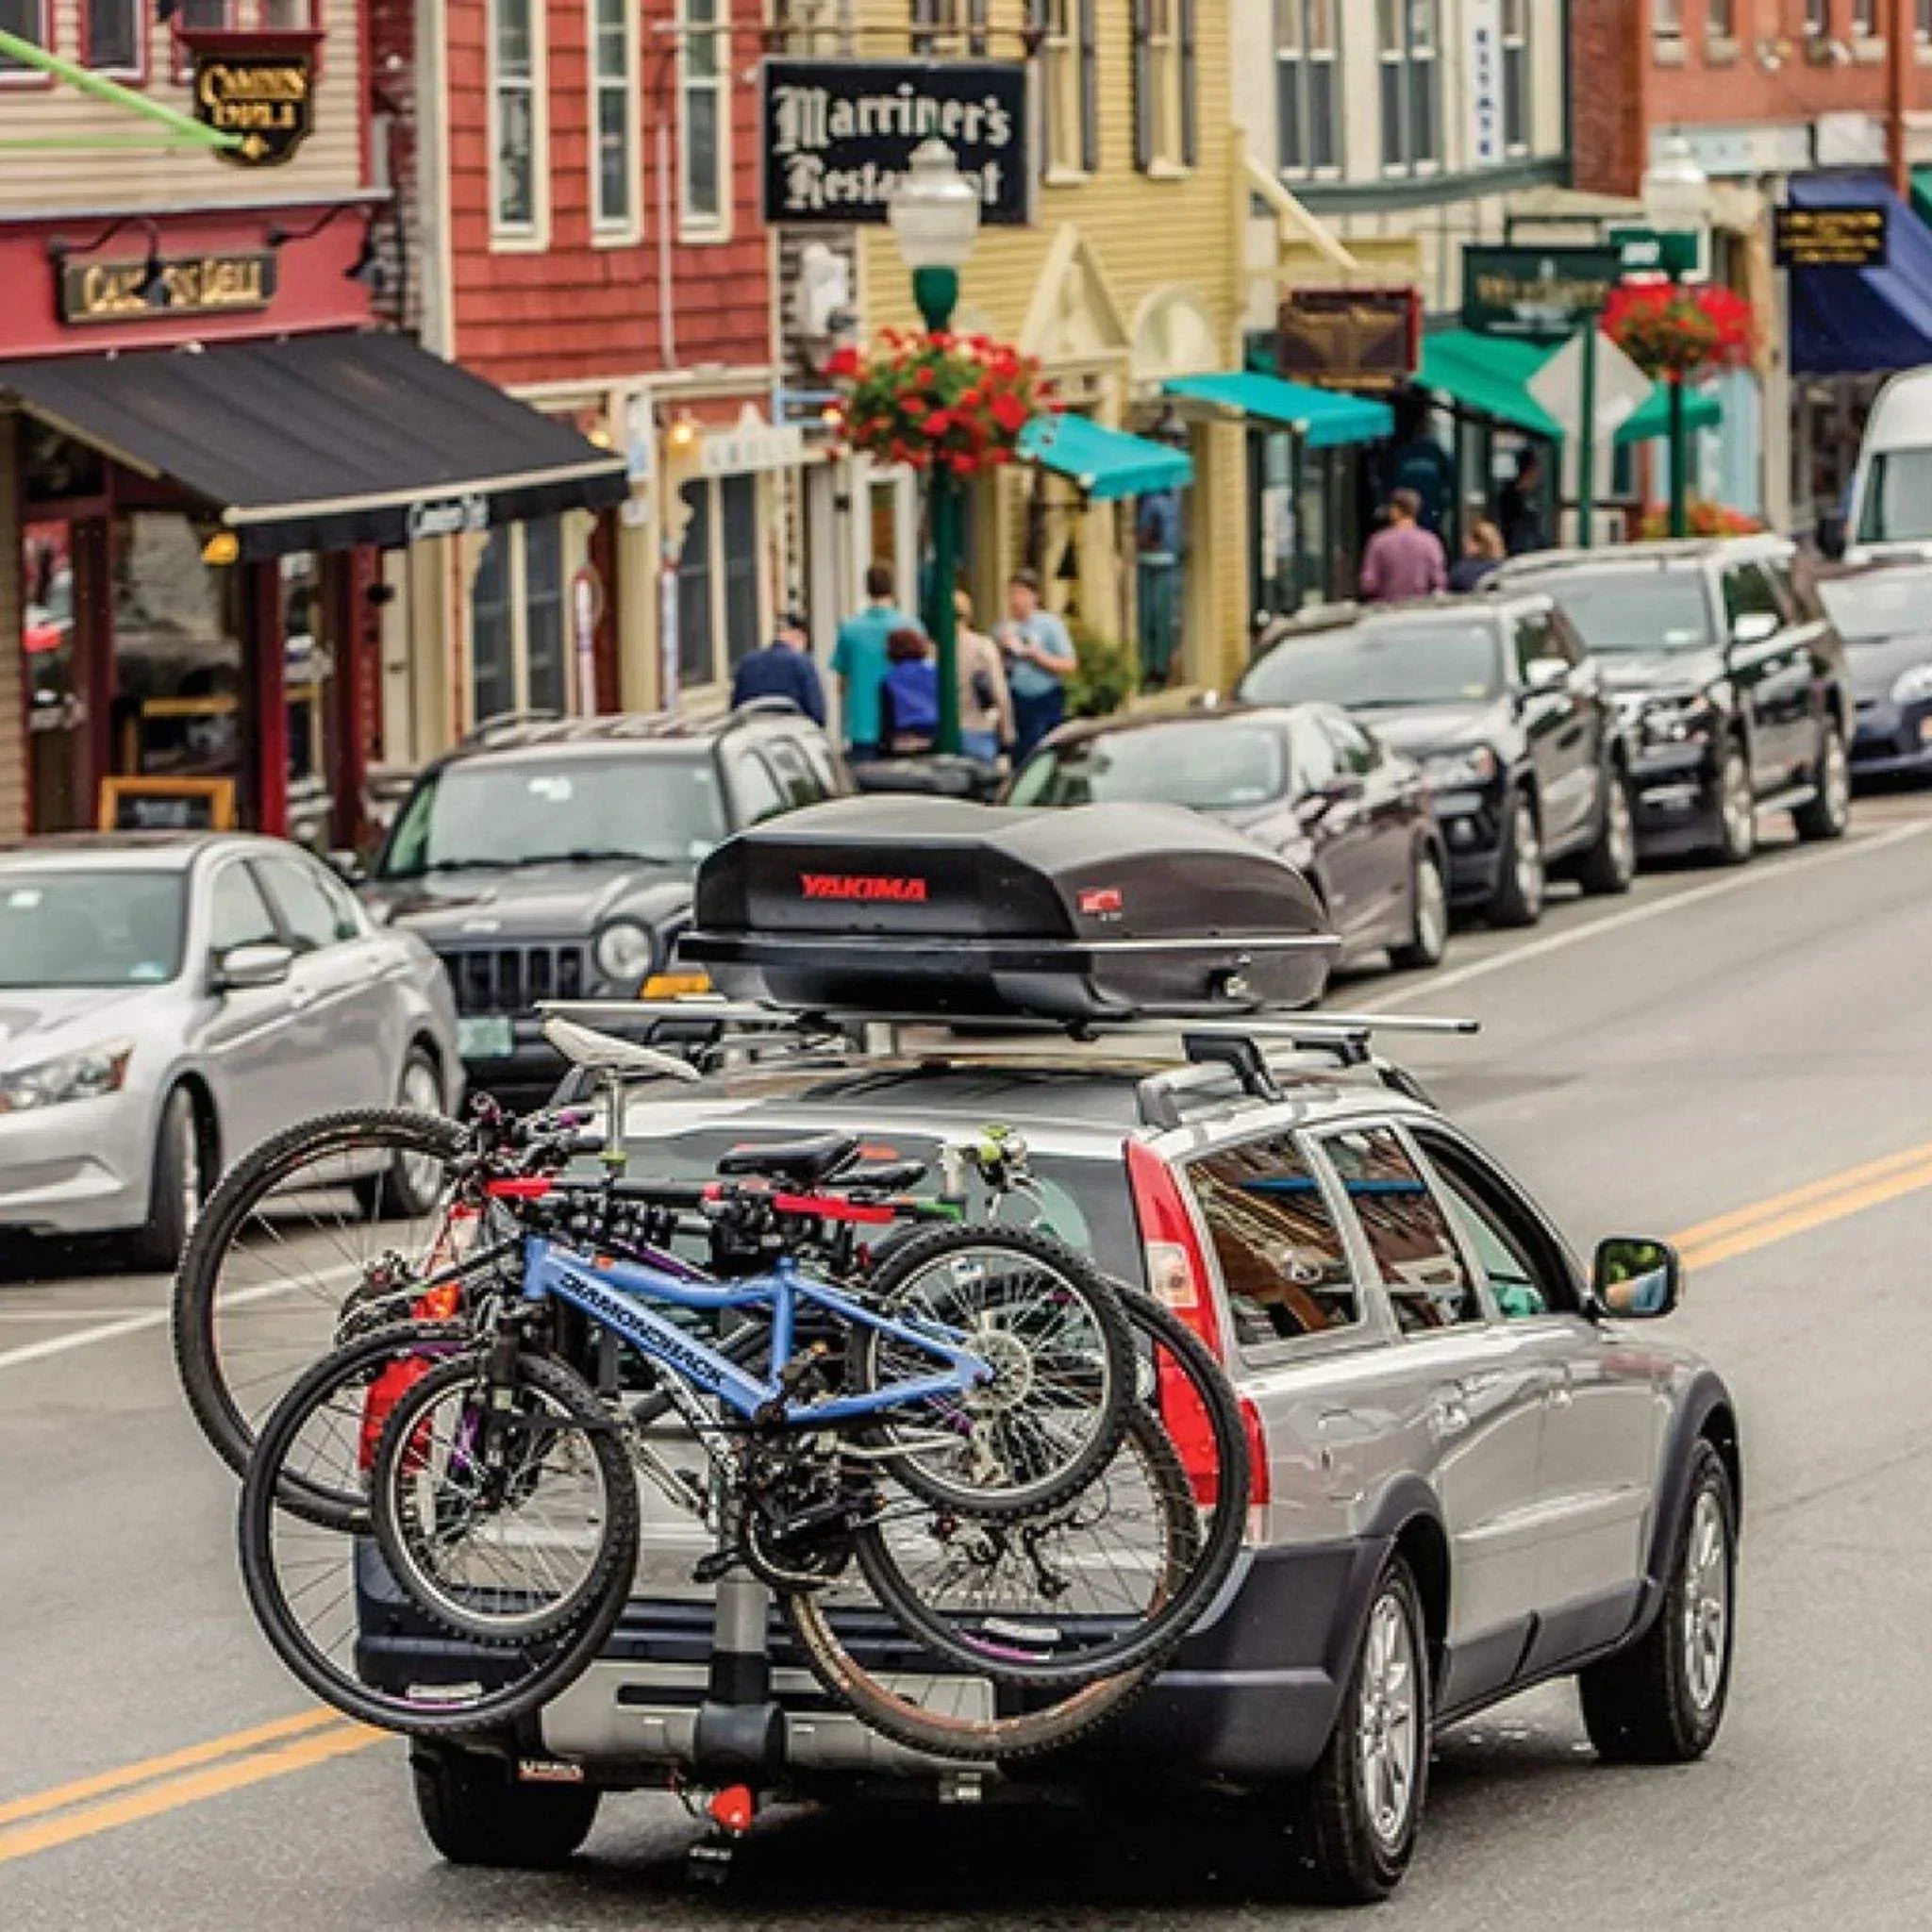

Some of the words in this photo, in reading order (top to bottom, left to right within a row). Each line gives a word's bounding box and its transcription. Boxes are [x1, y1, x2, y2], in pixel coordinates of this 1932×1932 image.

[773, 82, 1012, 154] Marriner's
[801, 874, 926, 903] YAKIMA
[558, 1271, 723, 1387] DIAMONDBACK
